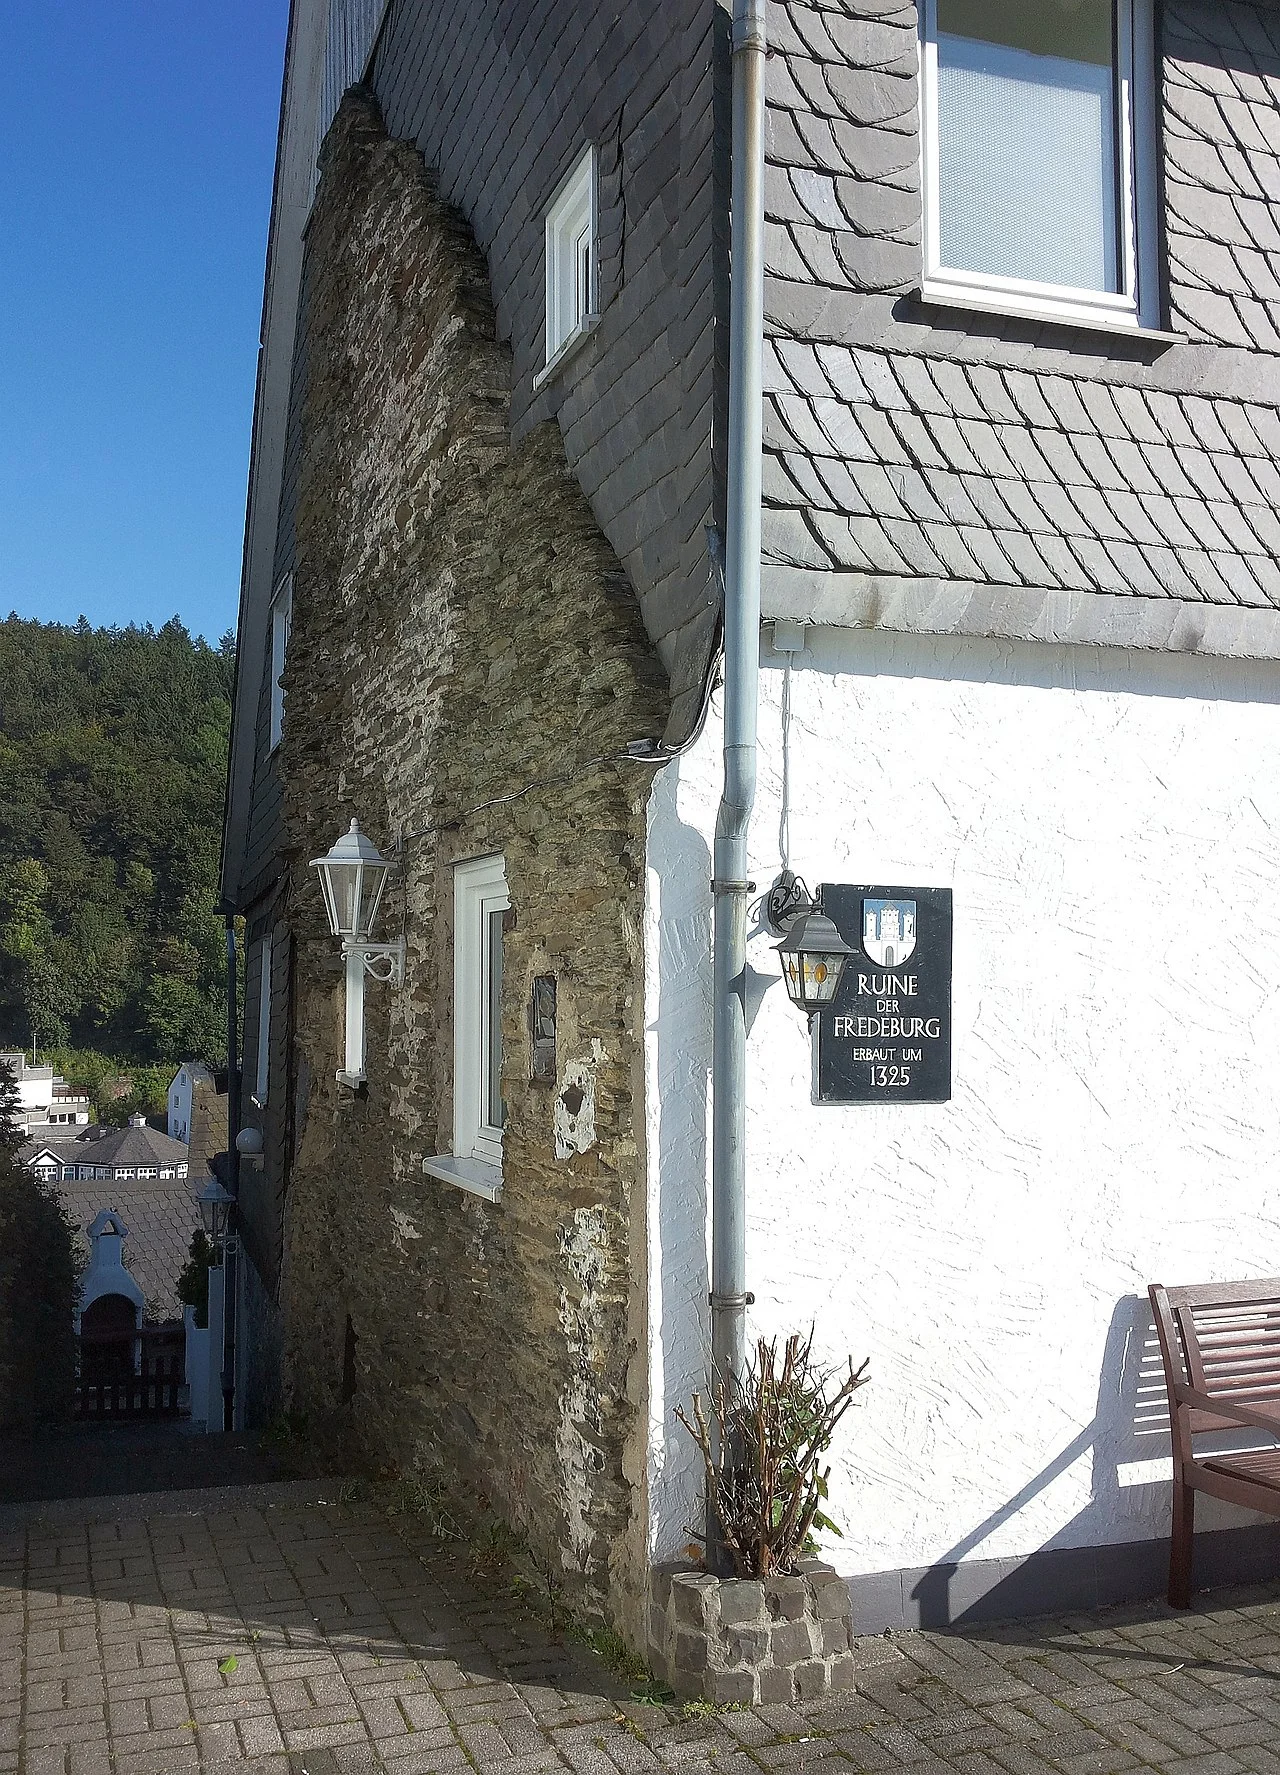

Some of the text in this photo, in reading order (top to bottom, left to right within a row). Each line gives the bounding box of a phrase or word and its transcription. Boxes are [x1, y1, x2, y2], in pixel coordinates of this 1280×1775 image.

[857, 974, 918, 996] RUINE
[876, 999, 900, 1013] DER
[833, 1016, 941, 1038] FREDEBURG
[853, 1048, 922, 1061] ERBAUT UM
[869, 1066, 911, 1086] 1325
